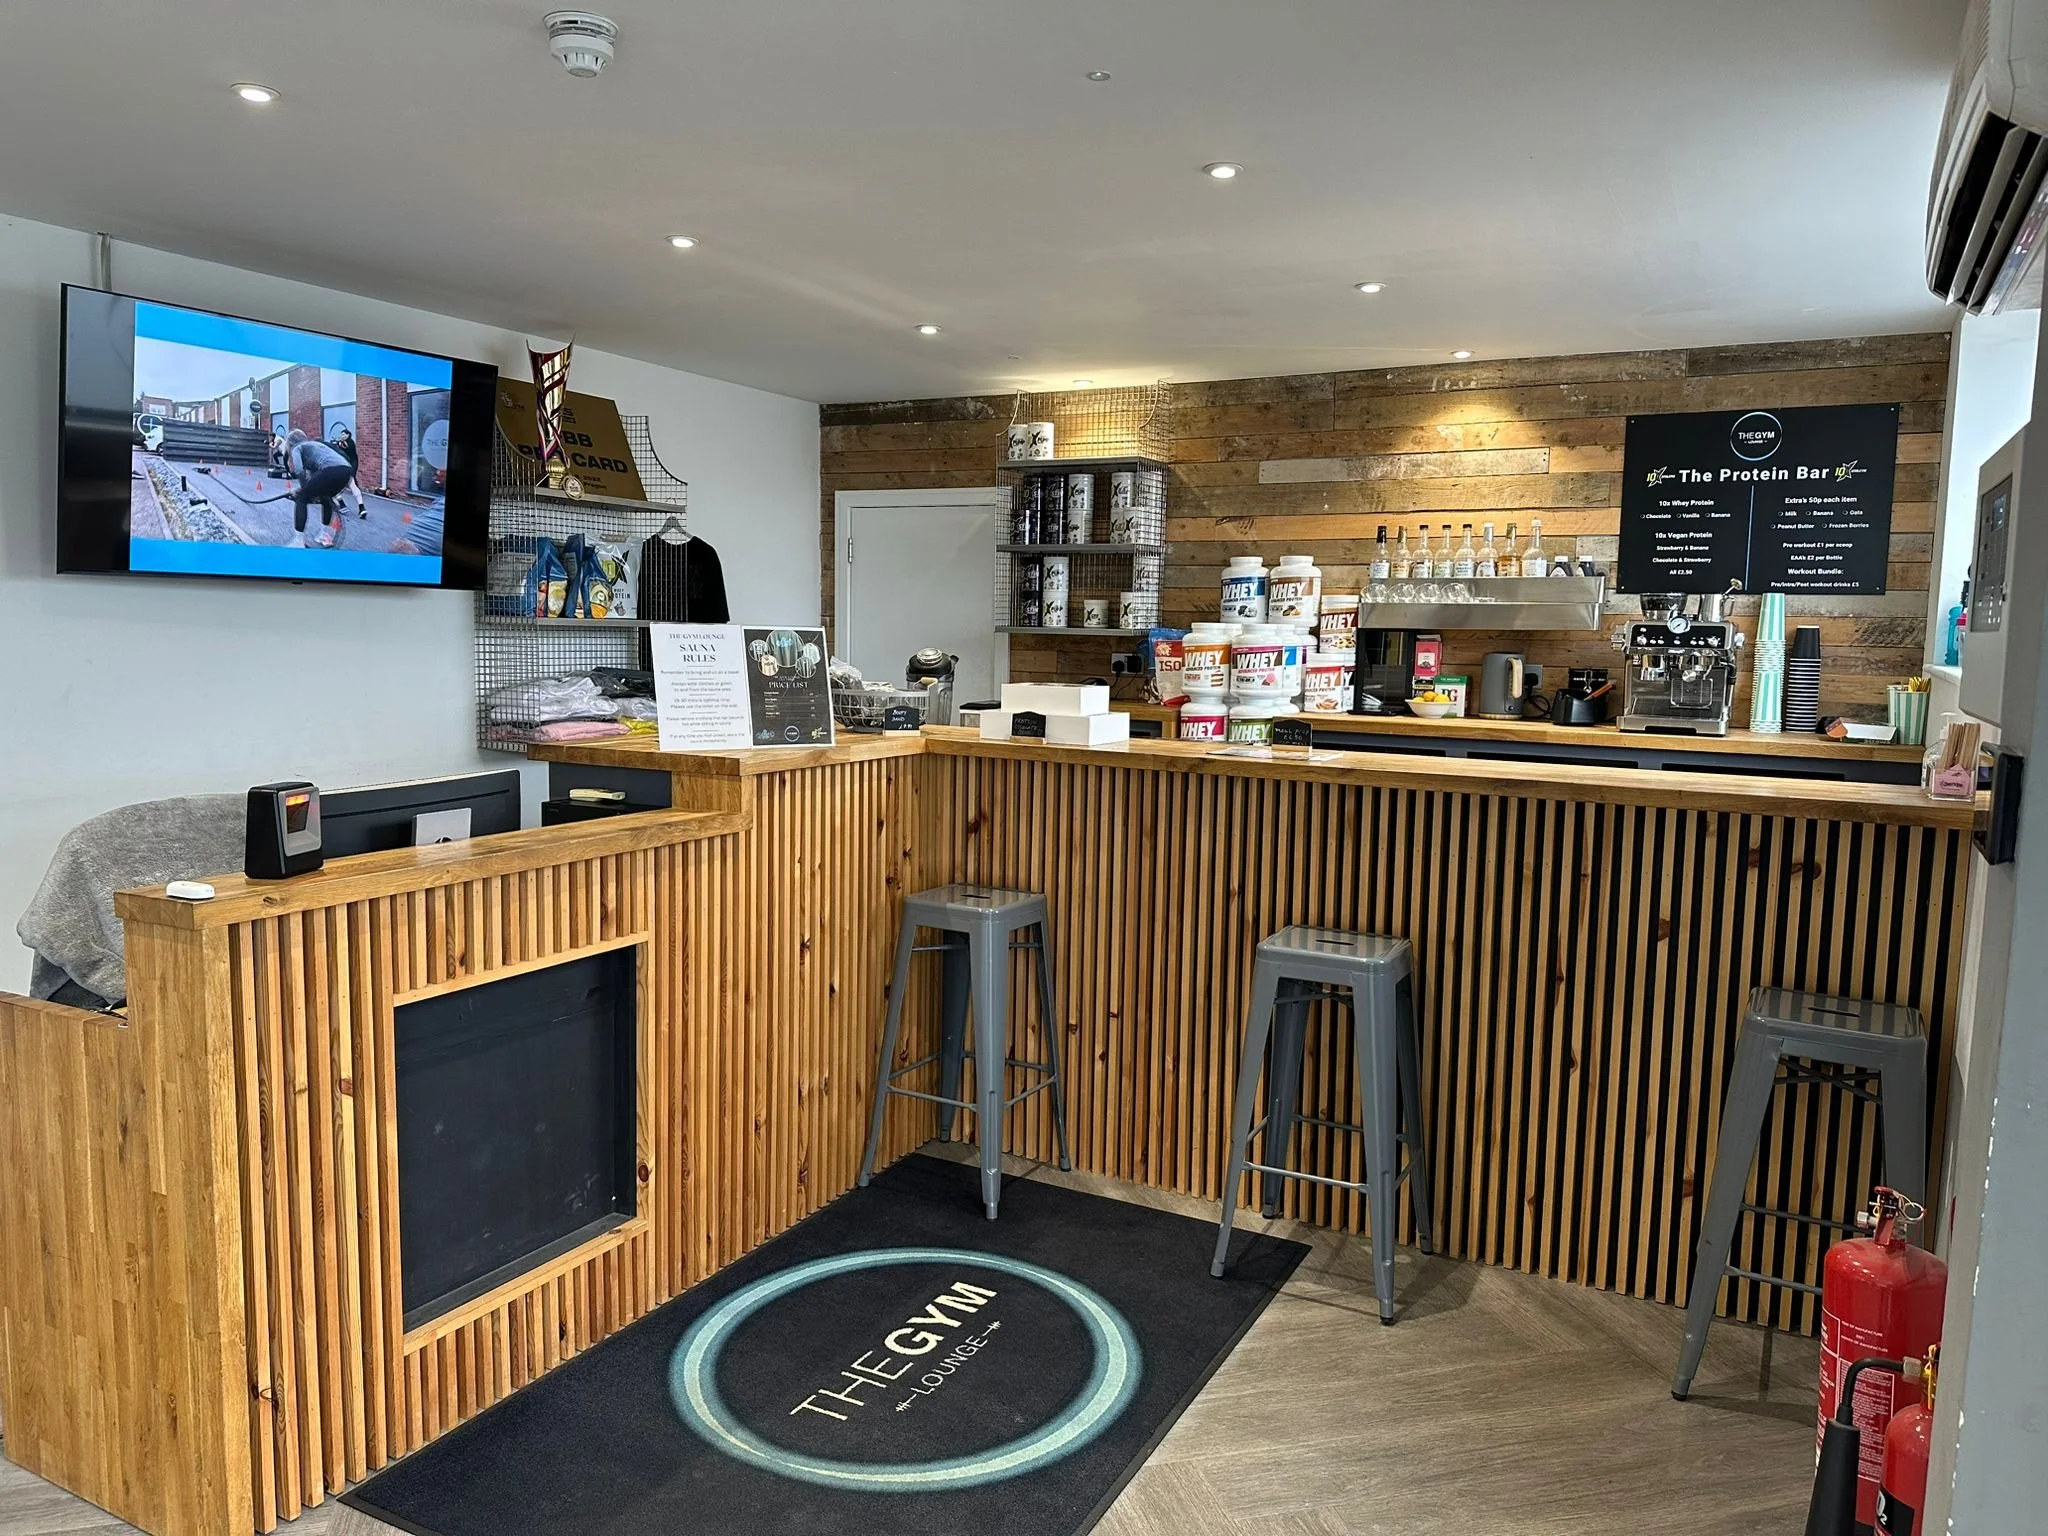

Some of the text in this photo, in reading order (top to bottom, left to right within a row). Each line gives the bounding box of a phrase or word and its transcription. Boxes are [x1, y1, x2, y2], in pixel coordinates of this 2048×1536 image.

[571, 452, 628, 473] CARD
[1679, 469, 1712, 483] The
[1720, 466, 1789, 481] Protein
[1796, 465, 1830, 480] Bar
[1671, 499, 1690, 508] Whey
[1808, 496, 1822, 505] 50p
[1667, 532, 1688, 540] Vegan
[1689, 531, 1713, 539] Protein
[1222, 582, 1259, 599] WHEY
[1270, 581, 1307, 599] WHEY
[1320, 613, 1355, 630] WHEY
[679, 643, 716, 652] SAUNA
[683, 654, 717, 663] RULES
[1184, 650, 1224, 667] WHEY
[1236, 651, 1279, 669] WHEY
[1305, 671, 1341, 689] WHEY
[1181, 721, 1217, 738] WHEY
[1231, 723, 1271, 740] WHEY
[910, 1335, 988, 1395] LOUNGE
